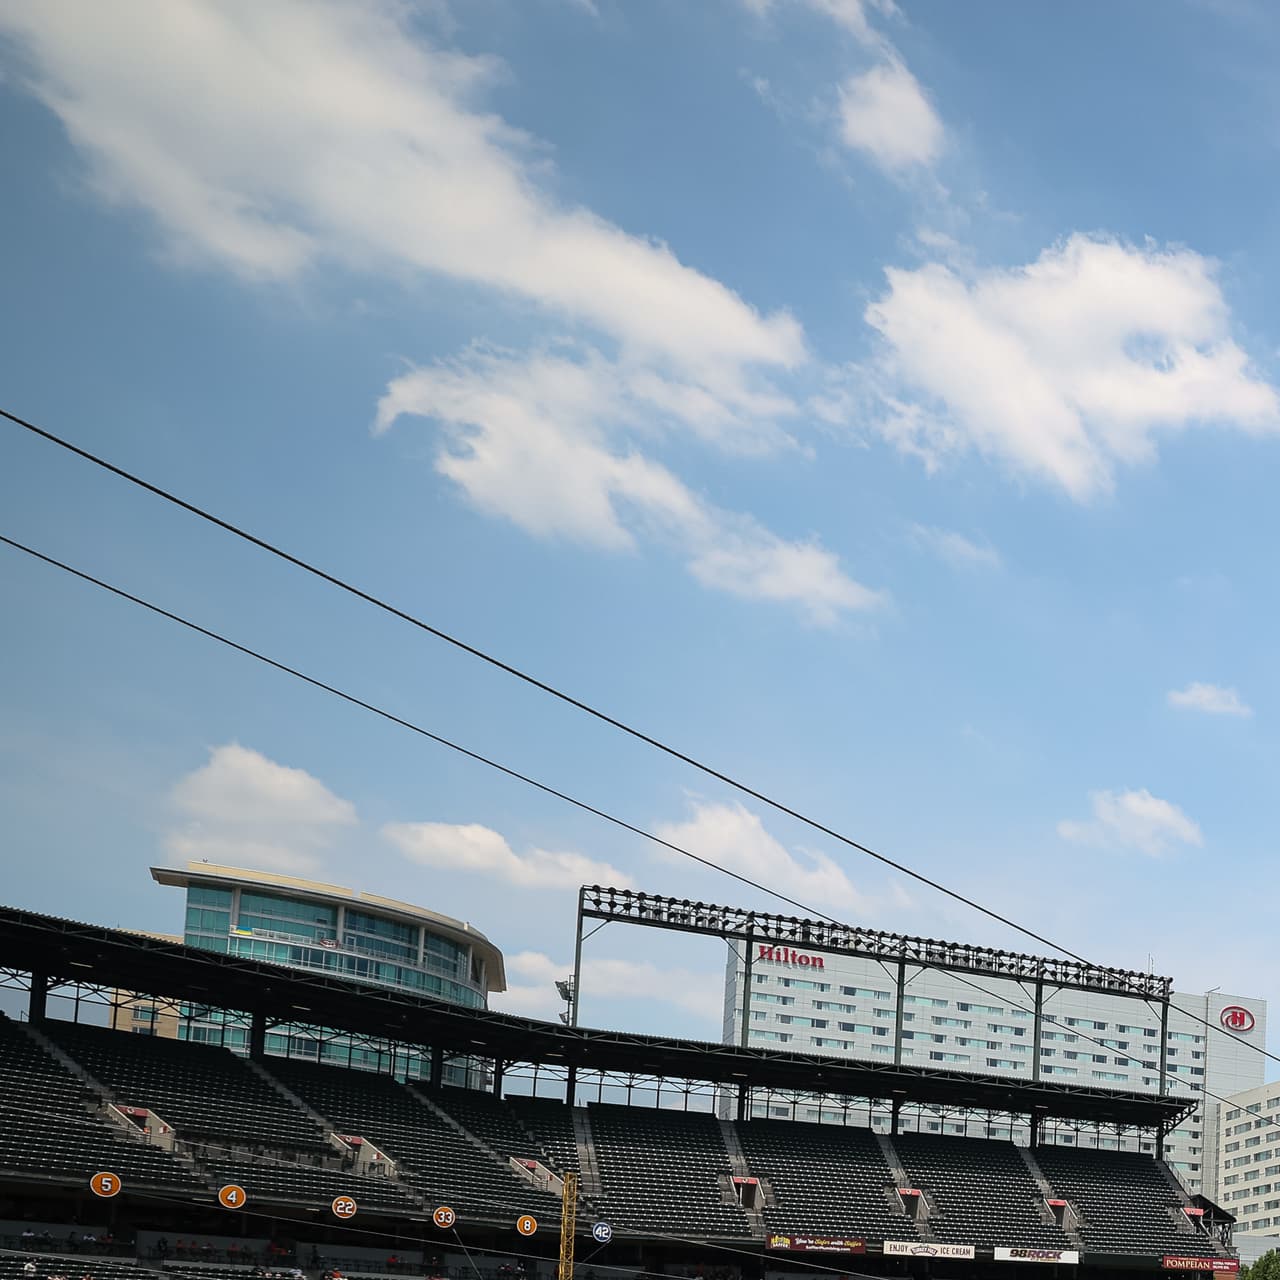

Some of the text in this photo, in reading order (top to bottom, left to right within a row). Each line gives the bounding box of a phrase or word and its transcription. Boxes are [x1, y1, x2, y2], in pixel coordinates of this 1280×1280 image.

[759, 945, 825, 967] Hilton
[101, 1177, 112, 1191] 5
[226, 1191, 237, 1203] 4
[336, 1202, 353, 1214] 22
[437, 1211, 452, 1223] 33
[523, 1220, 531, 1231] 8
[595, 1227, 609, 1238] 42
[890, 1244, 971, 1256] ENJOY ICE CREAM
[1166, 1260, 1210, 1269] POMPEIAN
